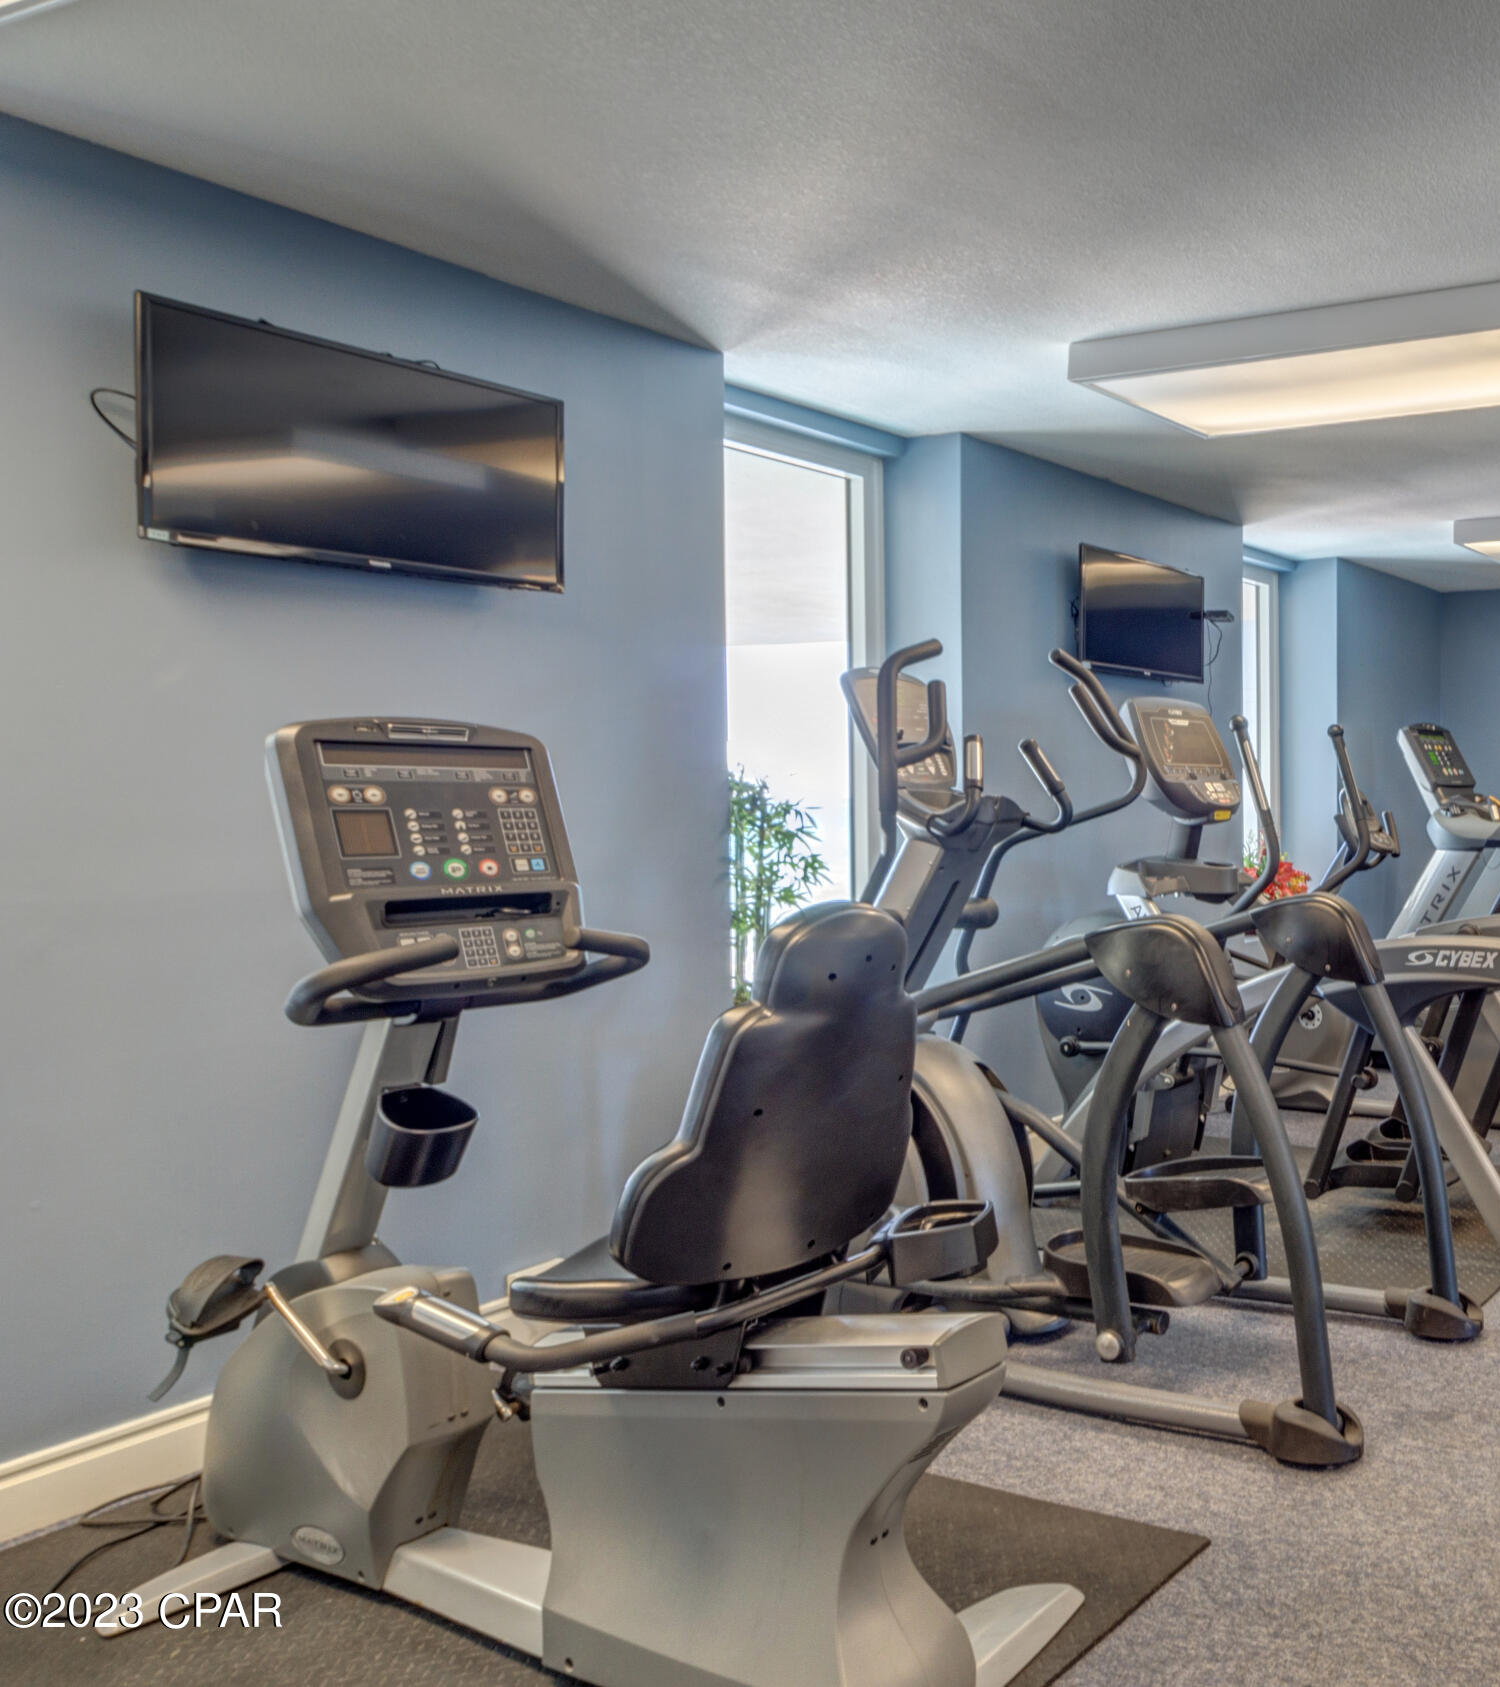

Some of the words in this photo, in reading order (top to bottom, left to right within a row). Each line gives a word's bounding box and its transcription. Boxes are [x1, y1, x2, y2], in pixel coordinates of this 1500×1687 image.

[440, 886, 503, 896] MATRIX
[1420, 864, 1461, 924] TRIX
[1435, 950, 1498, 968] CYBEX
